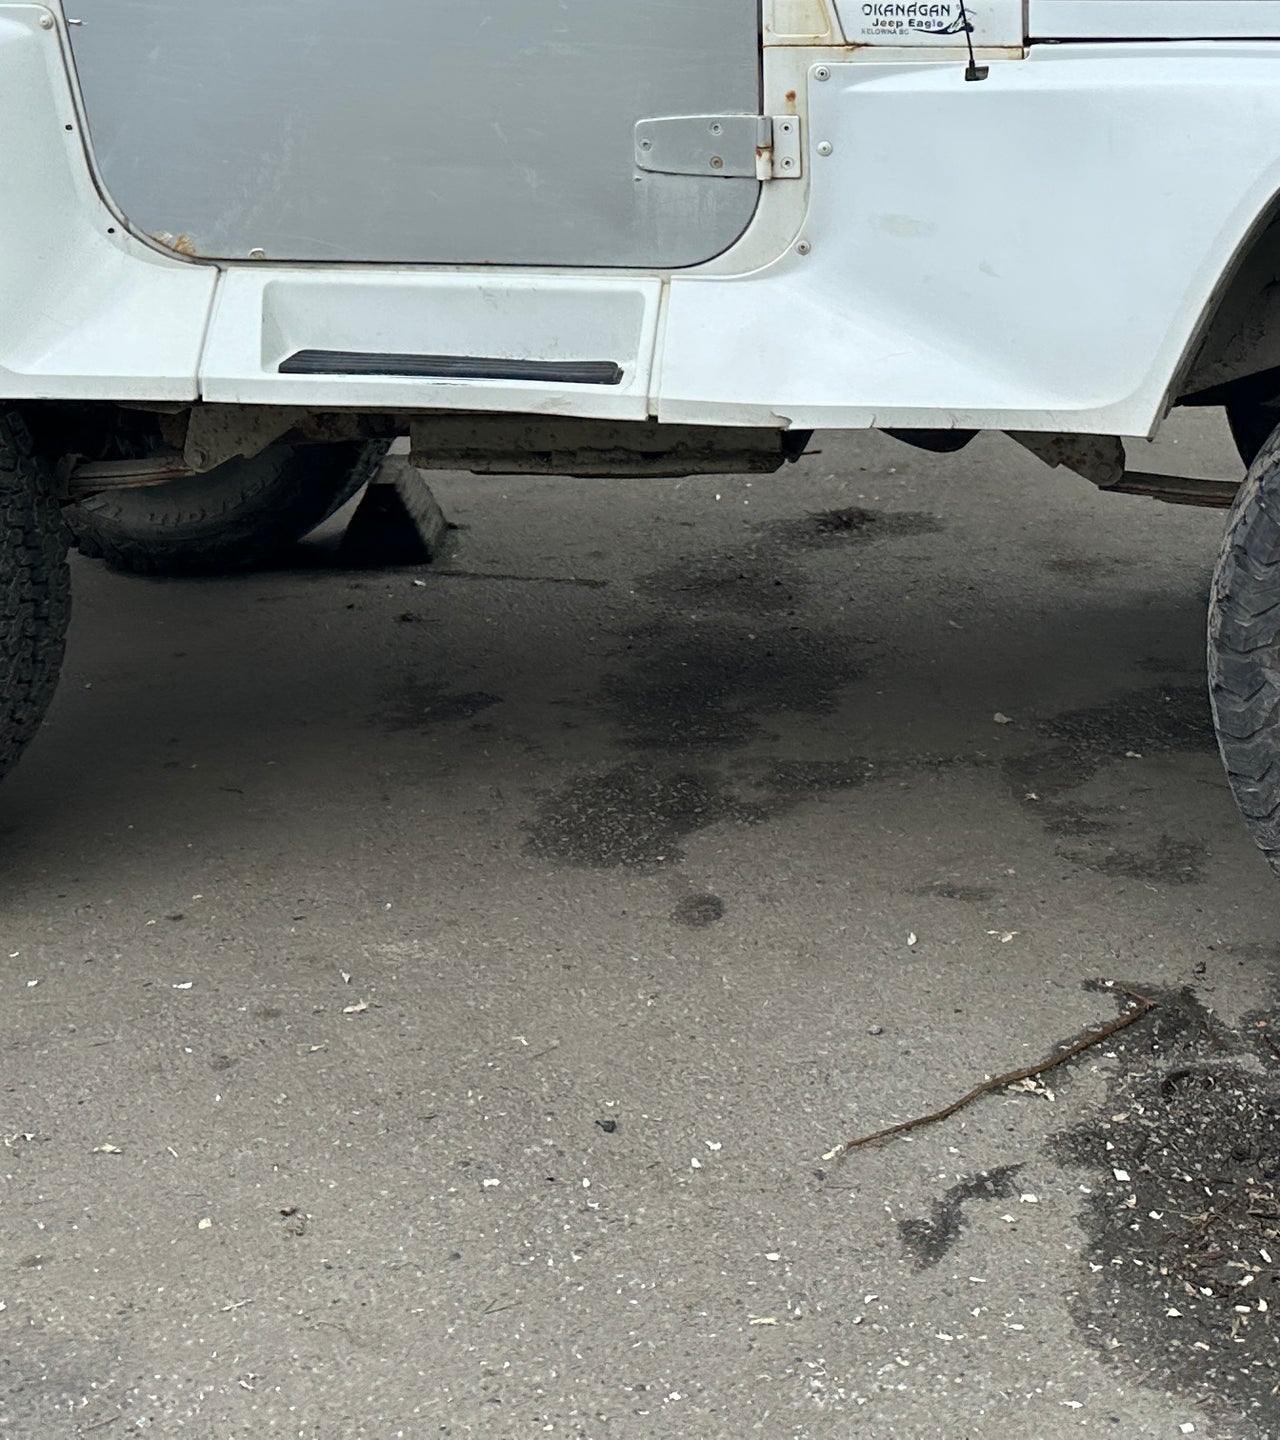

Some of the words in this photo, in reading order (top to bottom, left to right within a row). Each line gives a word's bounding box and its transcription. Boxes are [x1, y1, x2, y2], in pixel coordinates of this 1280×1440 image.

[862, 2, 950, 17] OKANAGAN
[872, 18, 903, 28] Jeep
[908, 18, 944, 29] Eagle
